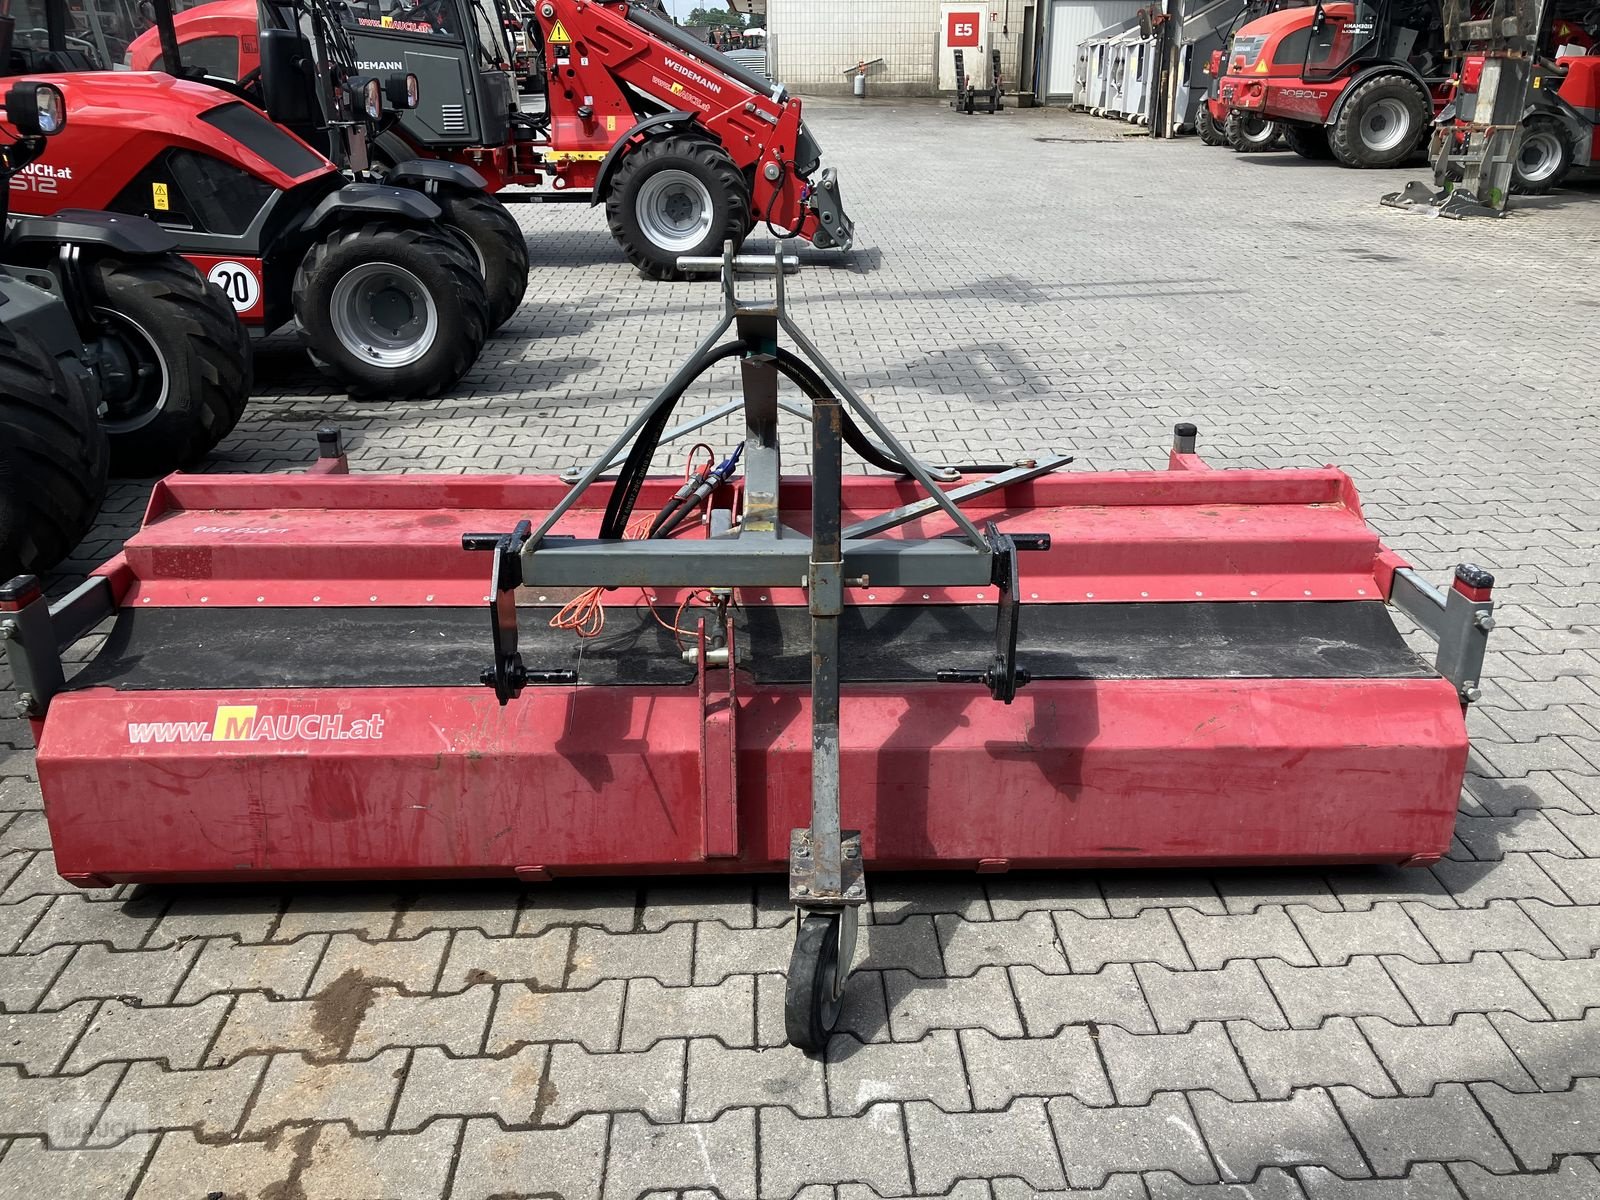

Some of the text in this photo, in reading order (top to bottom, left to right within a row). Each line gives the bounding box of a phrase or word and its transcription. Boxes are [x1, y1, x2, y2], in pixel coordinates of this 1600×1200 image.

[954, 23, 973, 37] E5
[354, 61, 403, 70] IDEMANN
[664, 57, 721, 94] WEIDEMANN
[9, 173, 58, 194] 512
[217, 270, 249, 303] 20
[128, 713, 385, 744] www.MAUCH.at
